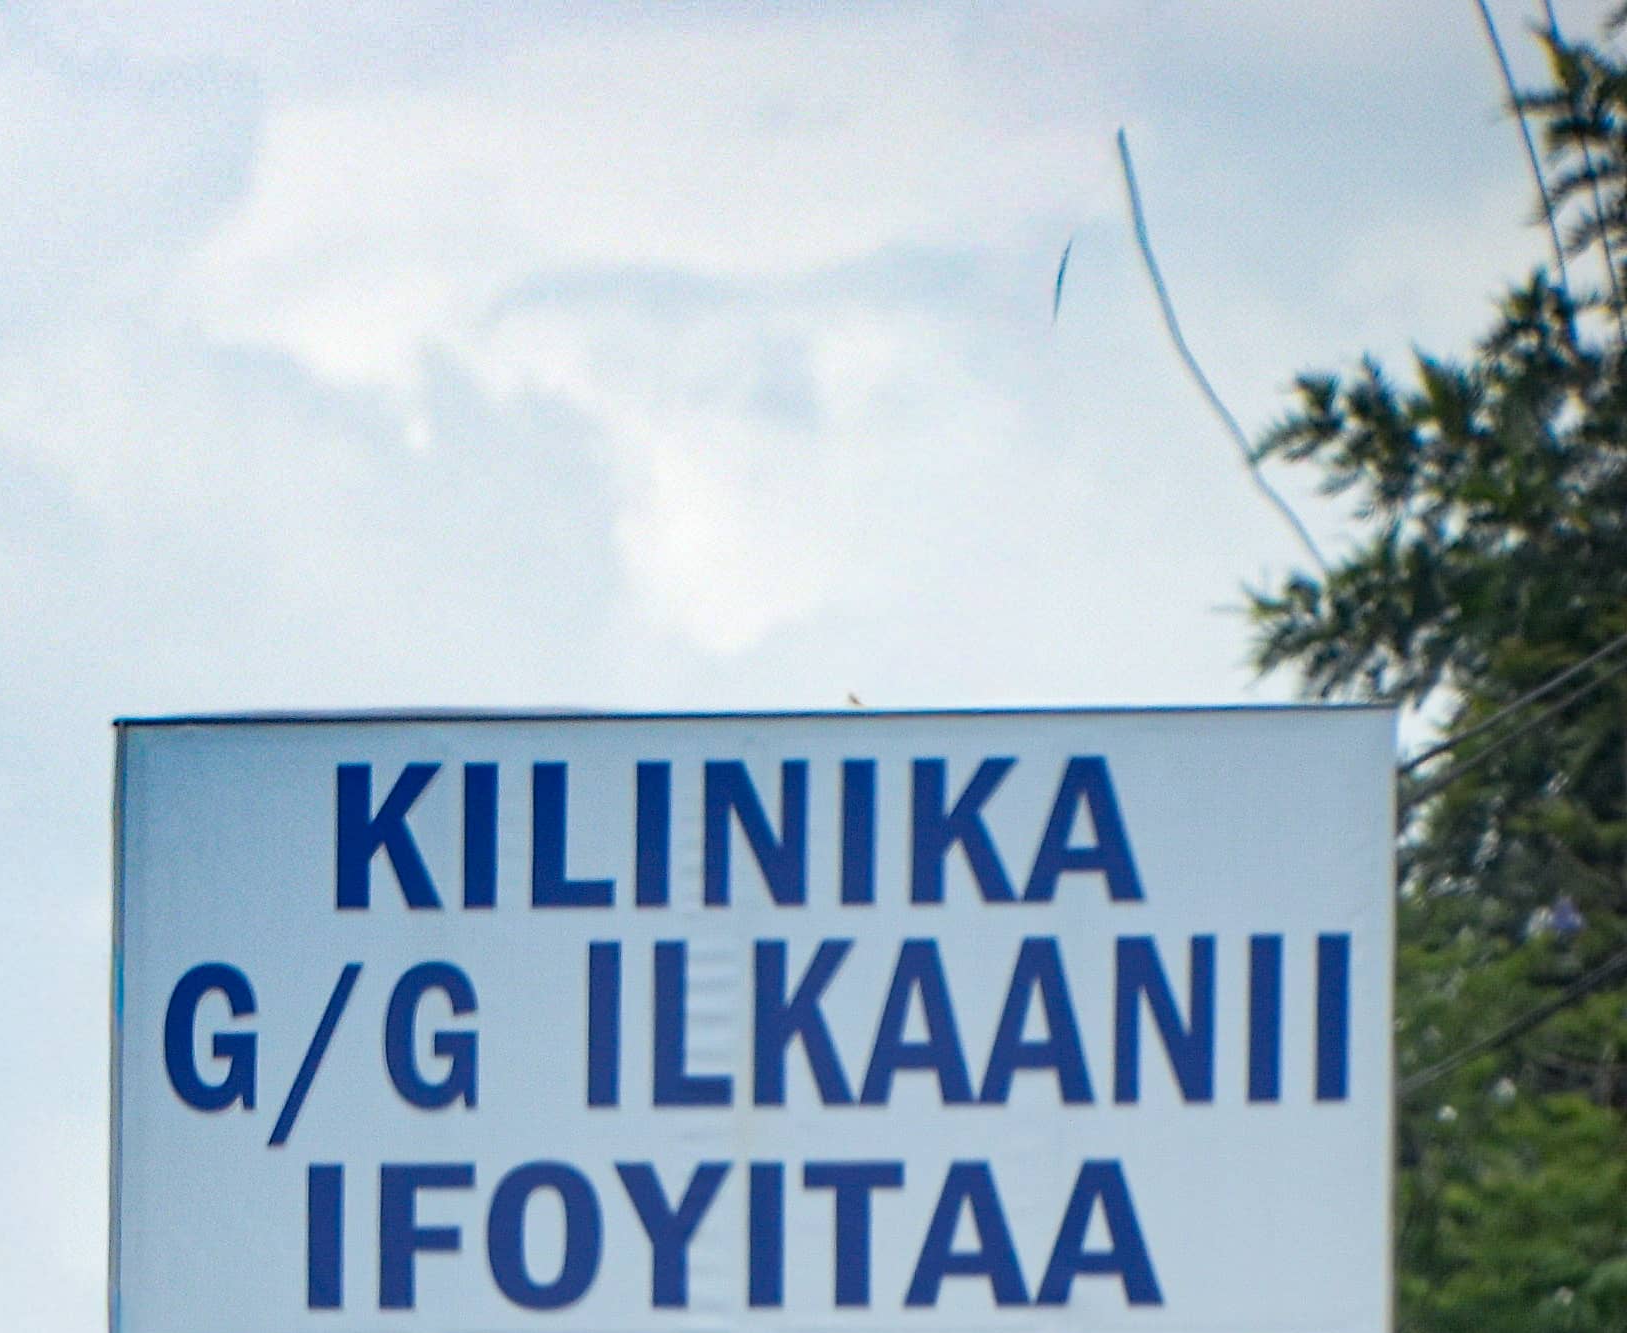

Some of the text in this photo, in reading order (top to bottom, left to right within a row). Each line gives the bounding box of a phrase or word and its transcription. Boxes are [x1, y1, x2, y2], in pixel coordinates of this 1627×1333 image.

[334, 754, 1146, 911] KILINIKA
[163, 932, 1351, 1147] G/G ILKAANII
[307, 1159, 1163, 1311] IFOYITAA
